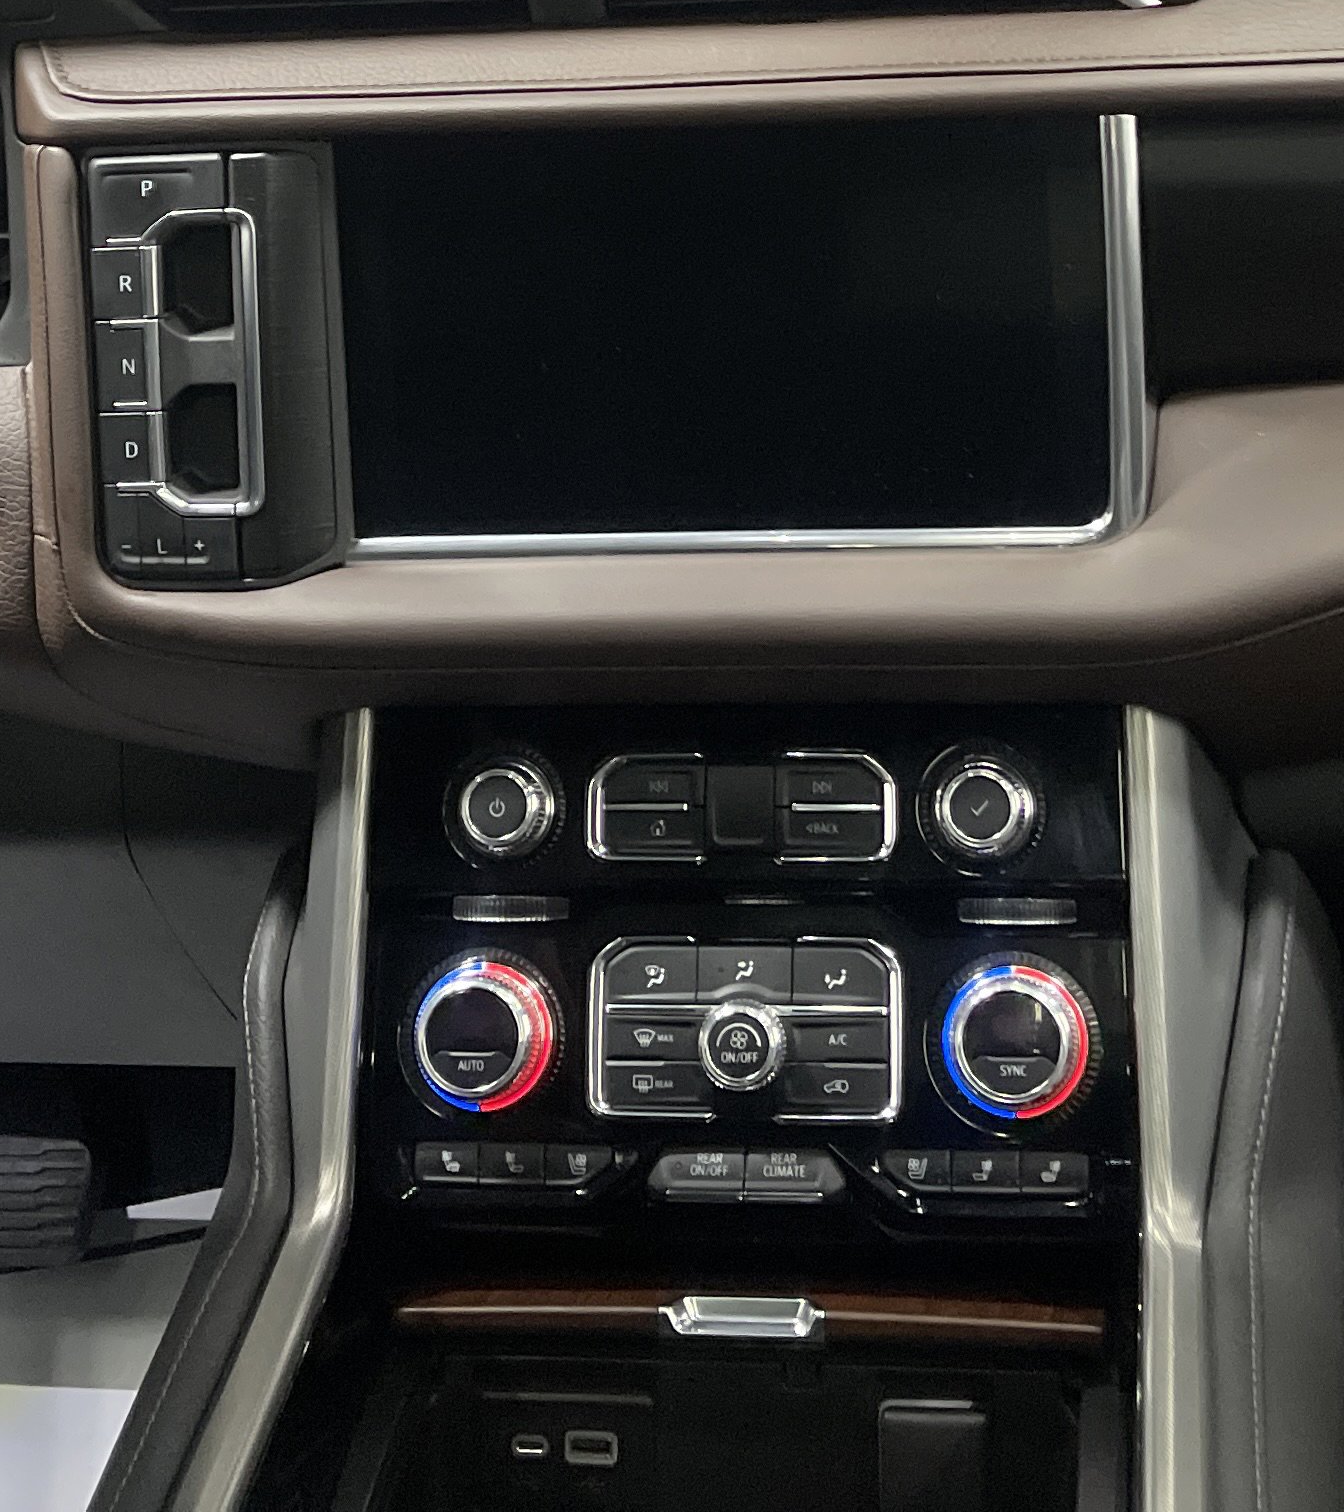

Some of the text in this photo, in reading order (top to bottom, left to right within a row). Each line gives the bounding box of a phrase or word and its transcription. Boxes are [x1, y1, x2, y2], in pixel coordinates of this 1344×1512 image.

[140, 180, 154, 197] P
[118, 275, 133, 293] R
[121, 359, 136, 375] N
[124, 442, 139, 459] D
[156, 538, 168, 555] L
[828, 1033, 848, 1046] A/C
[720, 1051, 759, 1064] ON/OFF
[457, 1059, 485, 1072] AUTO
[999, 1064, 1027, 1077] SYNC
[697, 1153, 723, 1163] REAR
[771, 1153, 798, 1164] REAR
[689, 1165, 729, 1177] ON/OFF
[762, 1165, 806, 1178] CLIMATE
